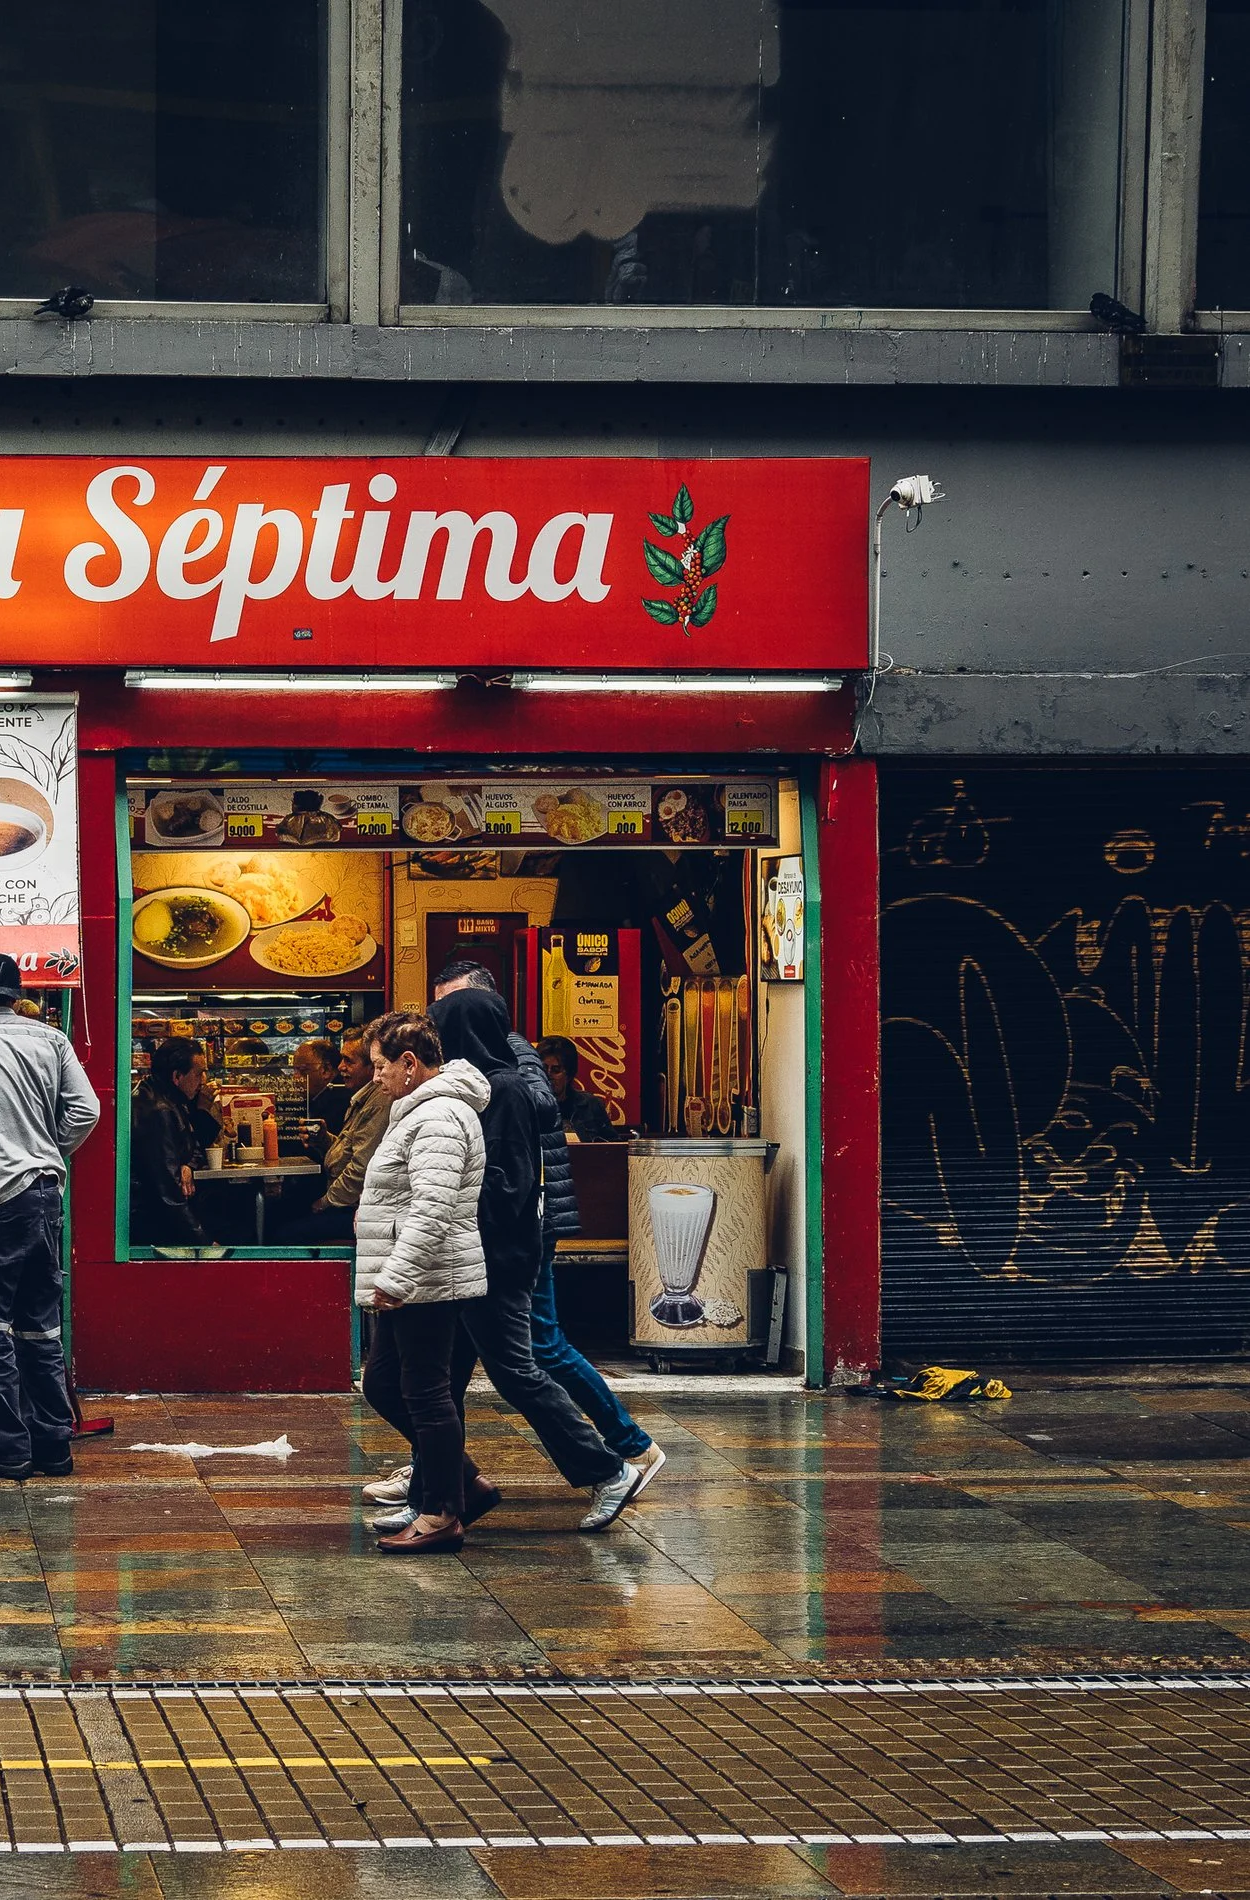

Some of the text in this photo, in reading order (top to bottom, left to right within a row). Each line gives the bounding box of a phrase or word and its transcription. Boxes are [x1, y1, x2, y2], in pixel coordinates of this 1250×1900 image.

[64, 465, 613, 642] Séptima
[728, 792, 768, 800] CALENTADO
[229, 825, 255, 837] 9.000
[358, 823, 387, 835] 12.000
[5, 879, 37, 890] CON
[576, 933, 609, 947] ÚNICO
